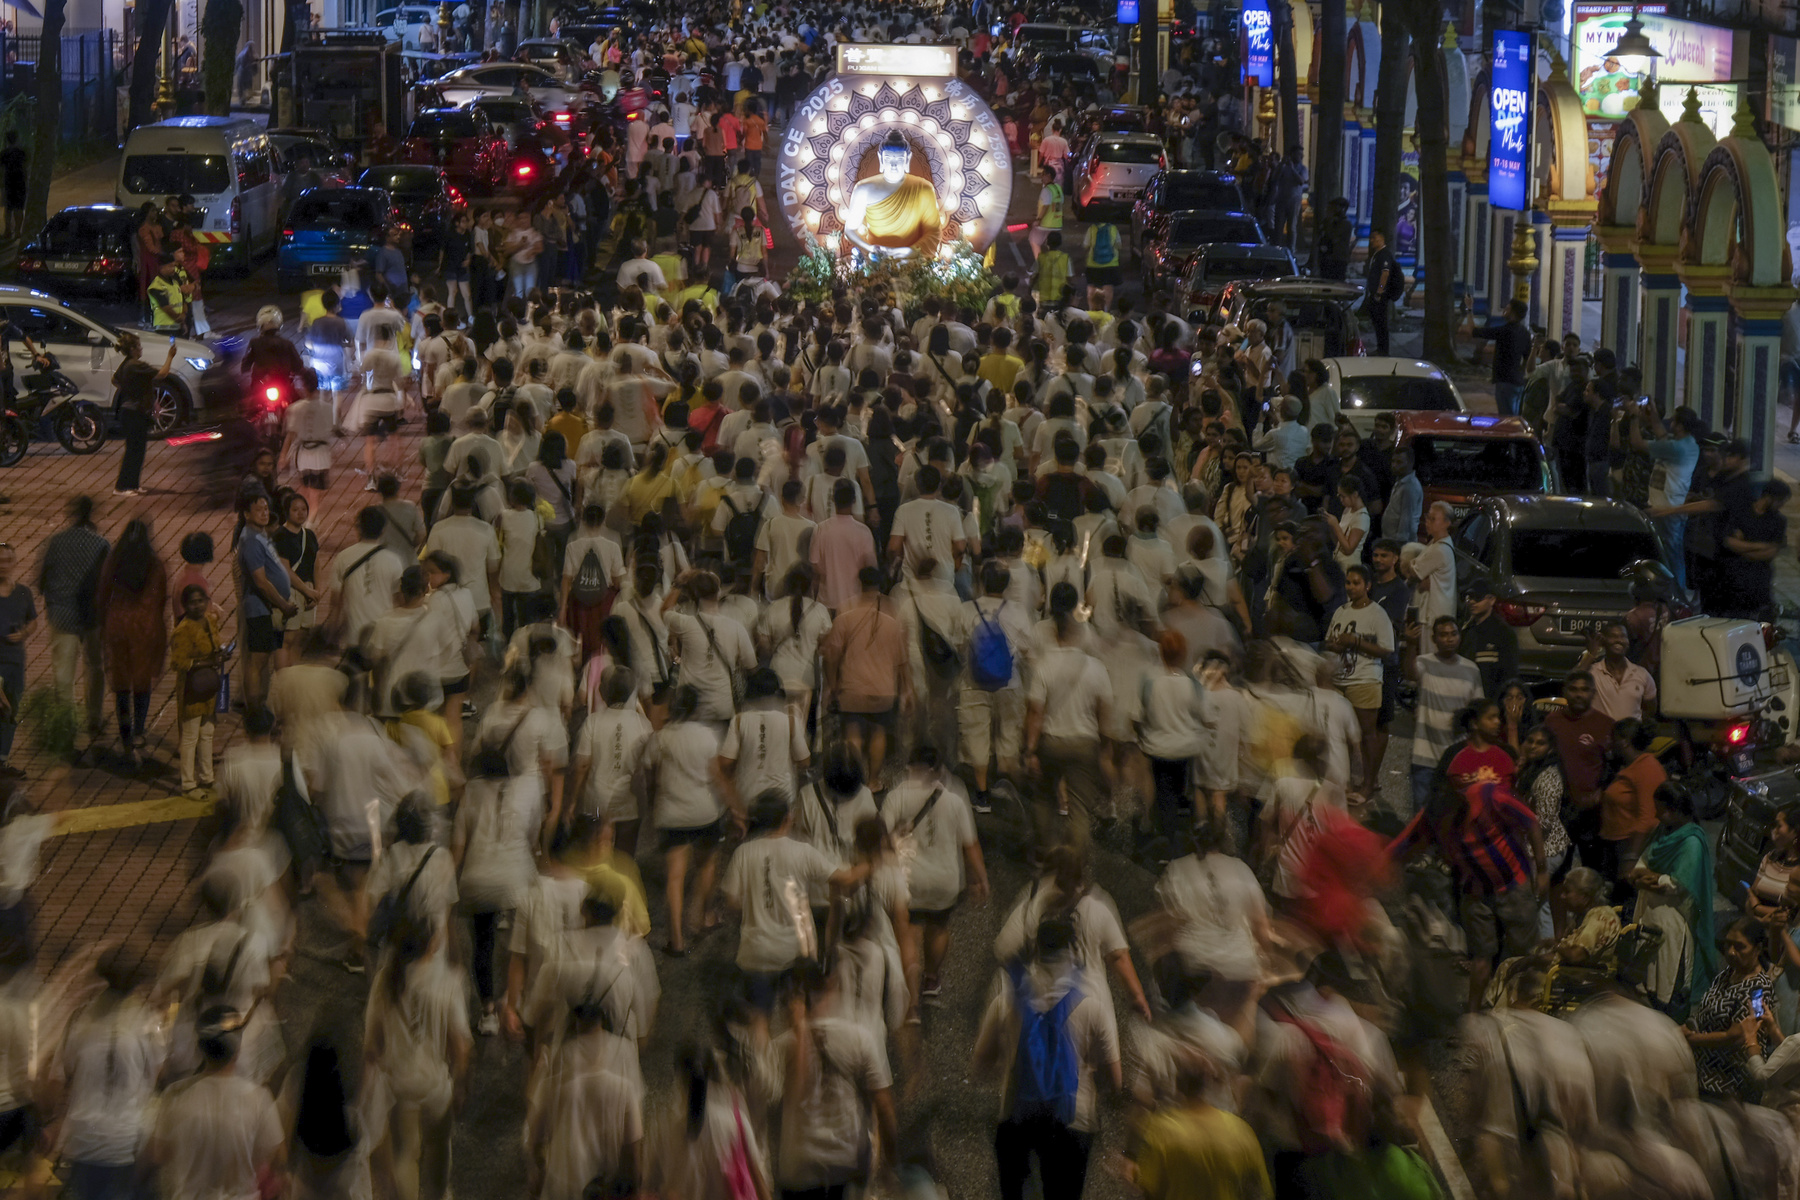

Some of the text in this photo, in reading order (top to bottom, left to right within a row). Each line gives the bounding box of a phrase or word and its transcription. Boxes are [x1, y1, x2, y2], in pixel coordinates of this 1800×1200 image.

[1243, 9, 1271, 26] OPEN
[1586, 32, 1602, 43] MY
[1665, 28, 1705, 68] Kuberah
[801, 78, 844, 123] 2025
[1493, 87, 1527, 114] OPEN
[944, 79, 1008, 170] 佛历 BE 2569
[784, 127, 805, 157] CE
[1501, 128, 1524, 153] Minds
[1509, 160, 1521, 171] MAY
[780, 163, 798, 206] DAY
